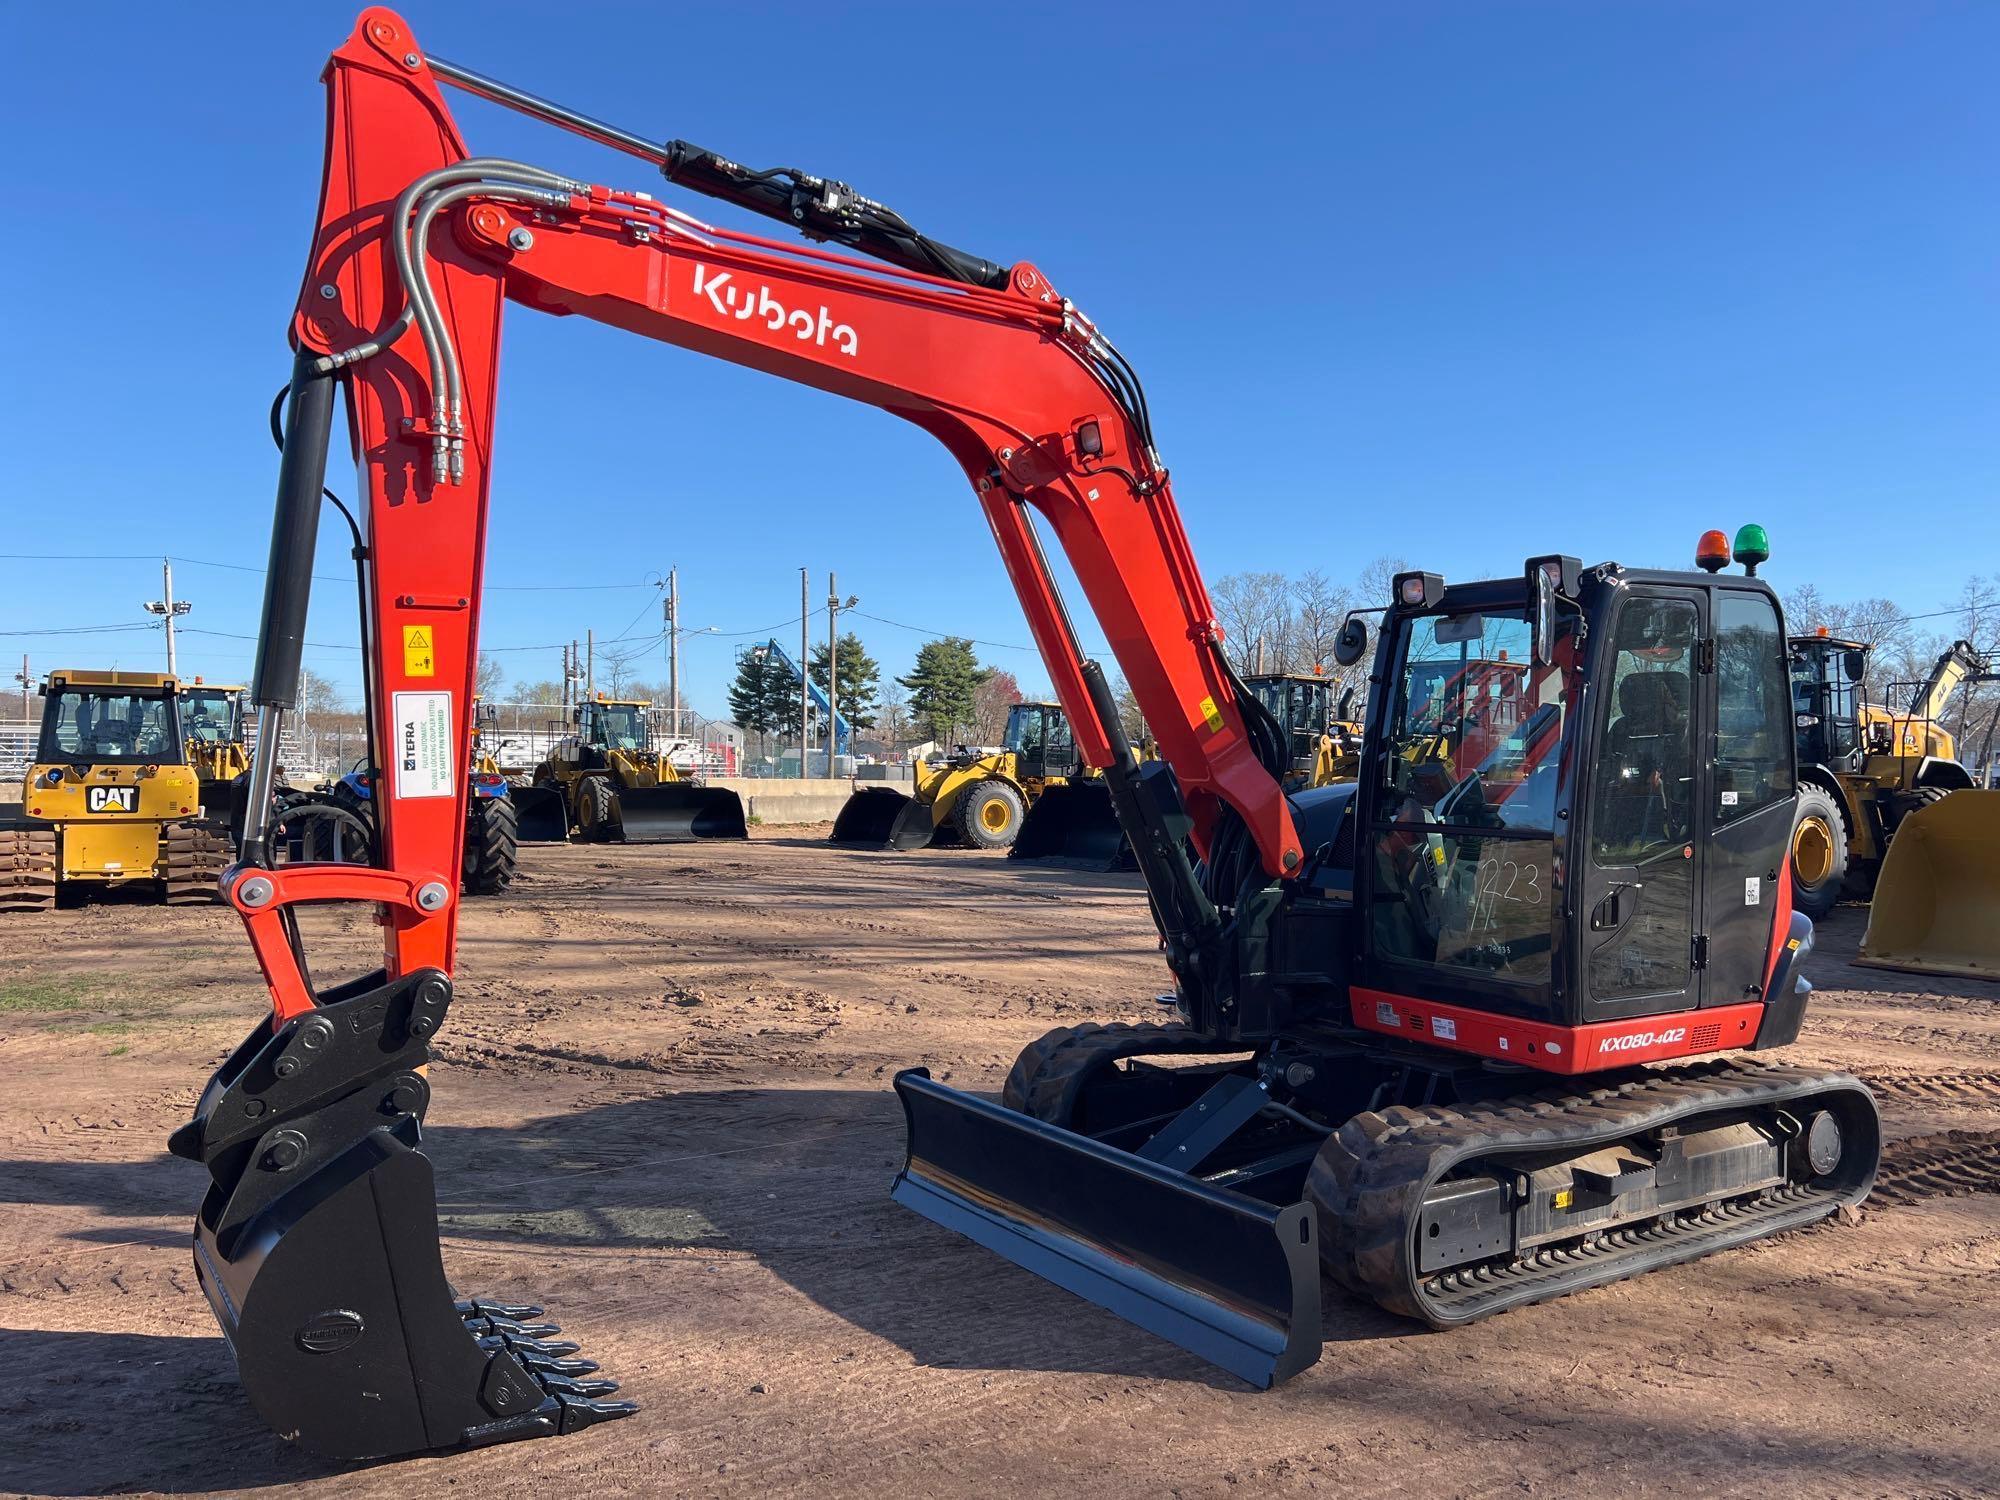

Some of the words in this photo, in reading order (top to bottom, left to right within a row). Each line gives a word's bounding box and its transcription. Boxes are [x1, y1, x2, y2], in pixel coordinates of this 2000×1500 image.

[693, 263, 858, 357] Kubota
[1937, 683, 1947, 702] JLG
[405, 722, 415, 758] TEFRA
[440, 771, 446, 780] NO
[91, 787, 134, 811] CAT
